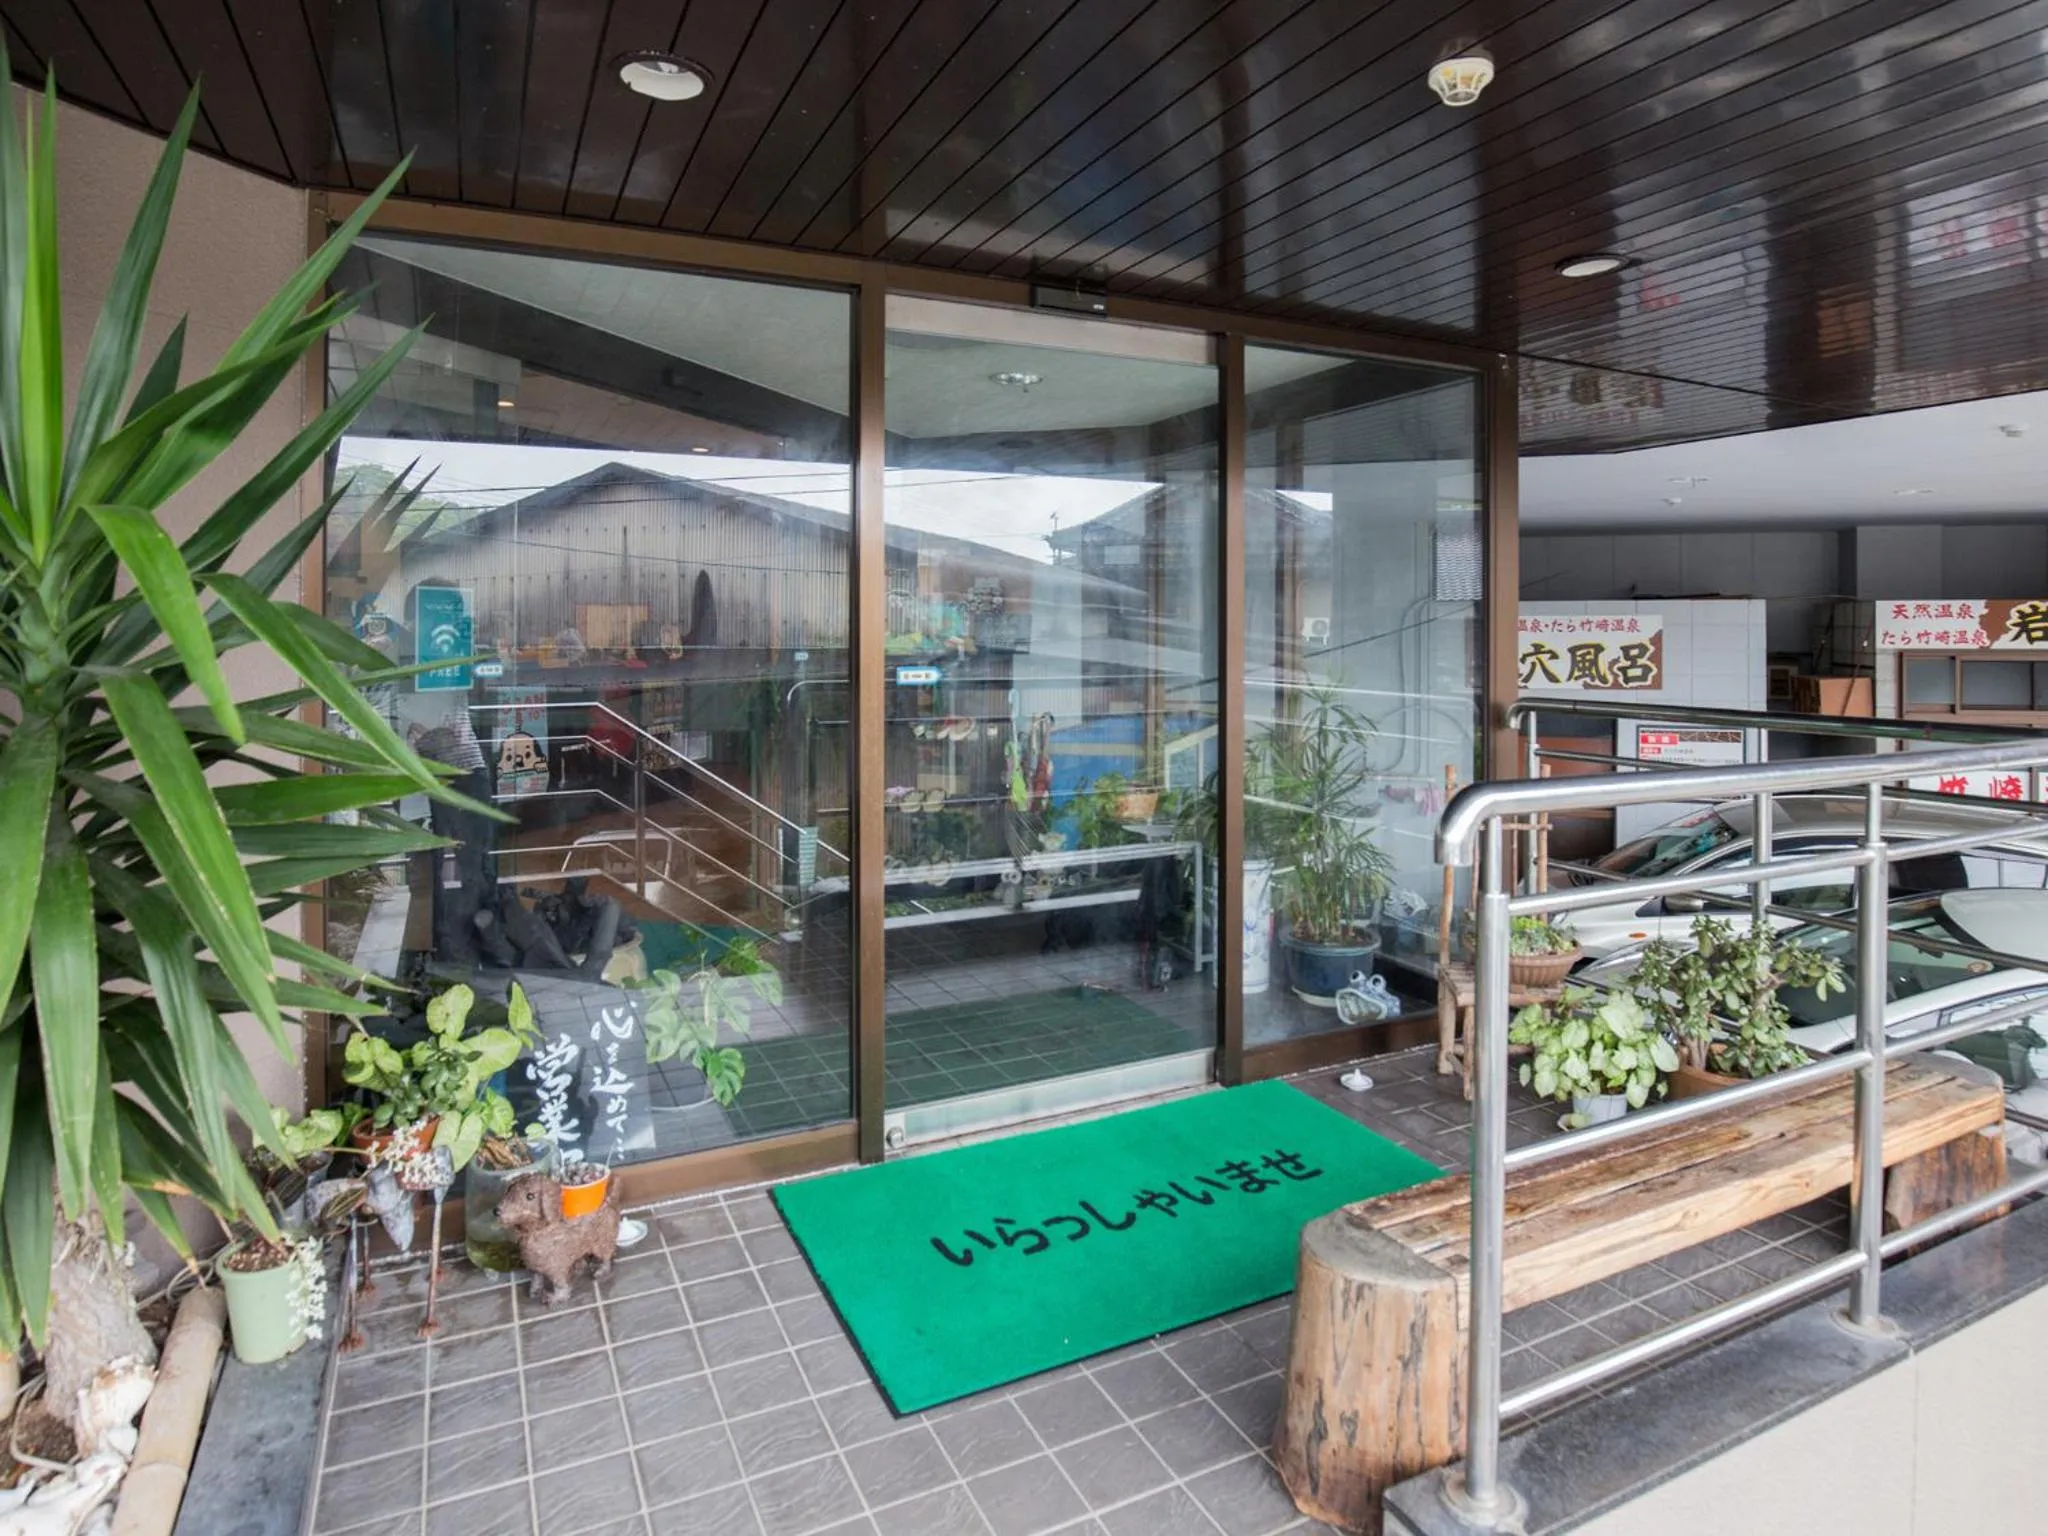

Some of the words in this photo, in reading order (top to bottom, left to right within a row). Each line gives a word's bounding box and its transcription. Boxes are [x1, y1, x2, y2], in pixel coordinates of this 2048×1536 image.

[1891, 603, 1975, 620] 天然温泉
[1881, 628, 1990, 646] たら竹崎温泉
[1518, 642, 1655, 686] 穴風呂
[930, 1149, 1324, 1266] いらっしゃいませ
